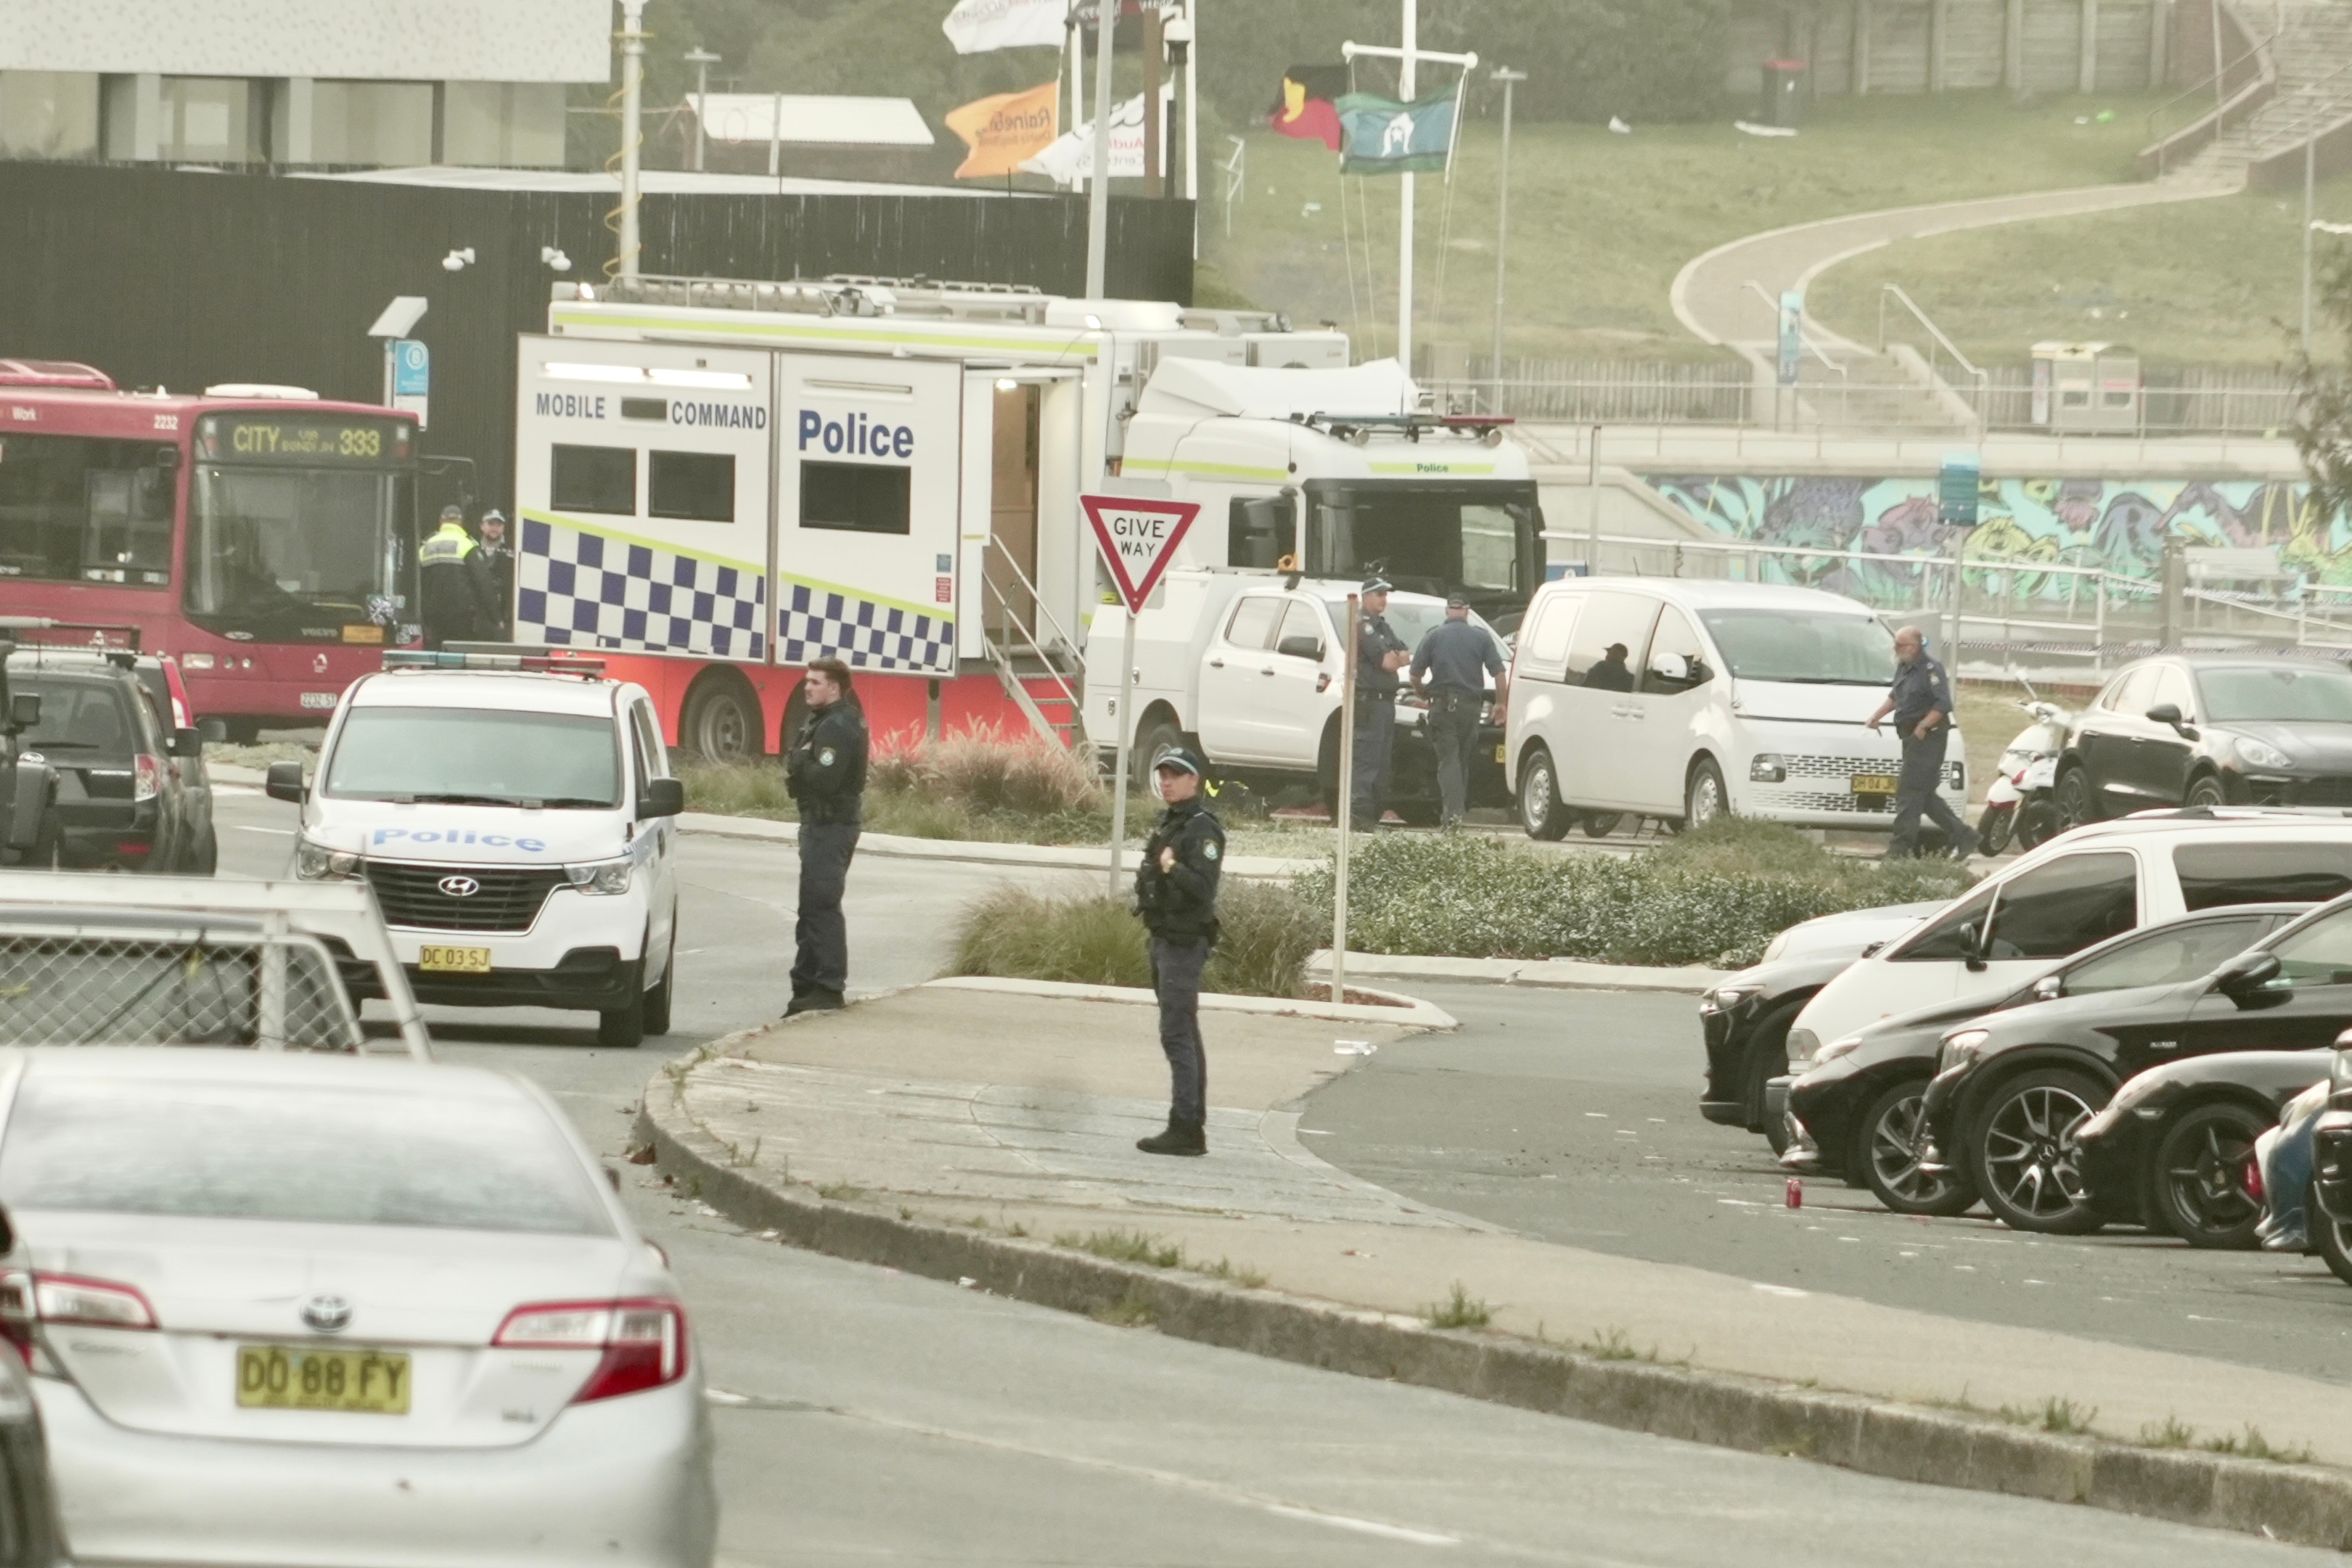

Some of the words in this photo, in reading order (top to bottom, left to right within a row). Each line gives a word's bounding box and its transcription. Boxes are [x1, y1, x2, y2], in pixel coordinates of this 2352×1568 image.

[12, 407, 37, 422] Work
[153, 414, 179, 430] 2232
[536, 393, 606, 419] MOBILE
[671, 401, 767, 430] COMMAND
[233, 424, 280, 453] CITY
[339, 429, 381, 456] 333
[798, 410, 914, 459] Police
[1417, 463, 1449, 473] Police
[1114, 517, 1165, 538] GIVE
[1120, 541, 1155, 557] WAY
[373, 828, 546, 853] Police
[422, 948, 441, 964] DC
[446, 948, 464, 965] 03
[470, 950, 488, 966] SJ
[302, 1355, 346, 1397] 88
[360, 1359, 406, 1400] FY
